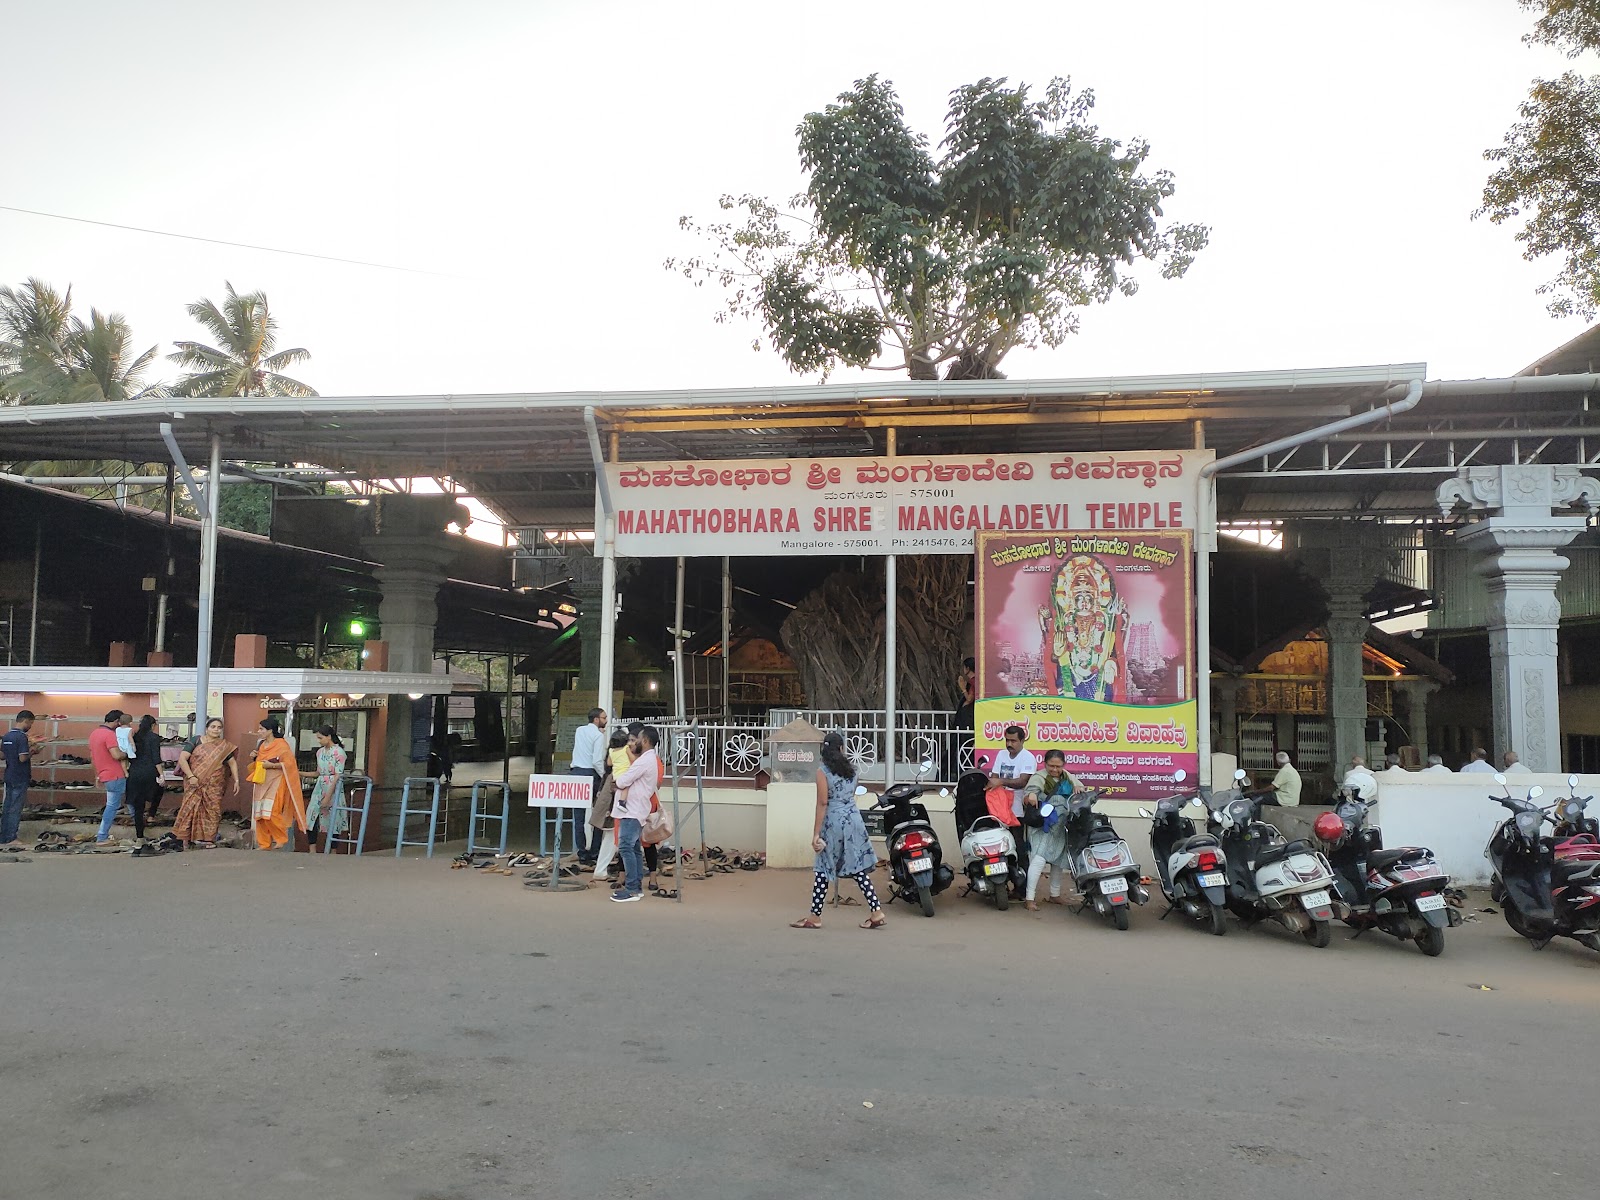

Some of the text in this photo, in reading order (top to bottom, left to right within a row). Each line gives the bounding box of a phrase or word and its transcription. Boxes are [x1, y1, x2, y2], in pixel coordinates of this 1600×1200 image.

[619, 454, 1183, 491] ಮಹತೋಭಾರ ಶ್ರೀ ಮಂಗಳಾದೇವಿ ದೇವಸ್ಥಾನ
[824, 490, 888, 500] ಮಂಗಳೂರು
[909, 489, 955, 498] 575001
[618, 507, 800, 534] MAHATHOBHARA
[898, 503, 1069, 531] MANGALADEVI
[1086, 501, 1183, 529] TEMPLE
[781, 540, 834, 549] Mangalore
[892, 539, 909, 547] Ph:
[961, 538, 974, 546] 24
[1054, 537, 1067, 559] ಶ್ರೀ
[1071, 535, 1130, 556] ಮಂಗಳಾದೇವಿ
[324, 697, 347, 708] SEVA
[348, 697, 387, 708] COUNTER
[1014, 701, 1026, 713] ಶ್ರೀ
[1037, 714, 1119, 743] ಸಾಮೂಹಿಕ
[1126, 716, 1188, 749] ವಿವಾಹವು
[531, 781, 591, 801] NO PARKING
